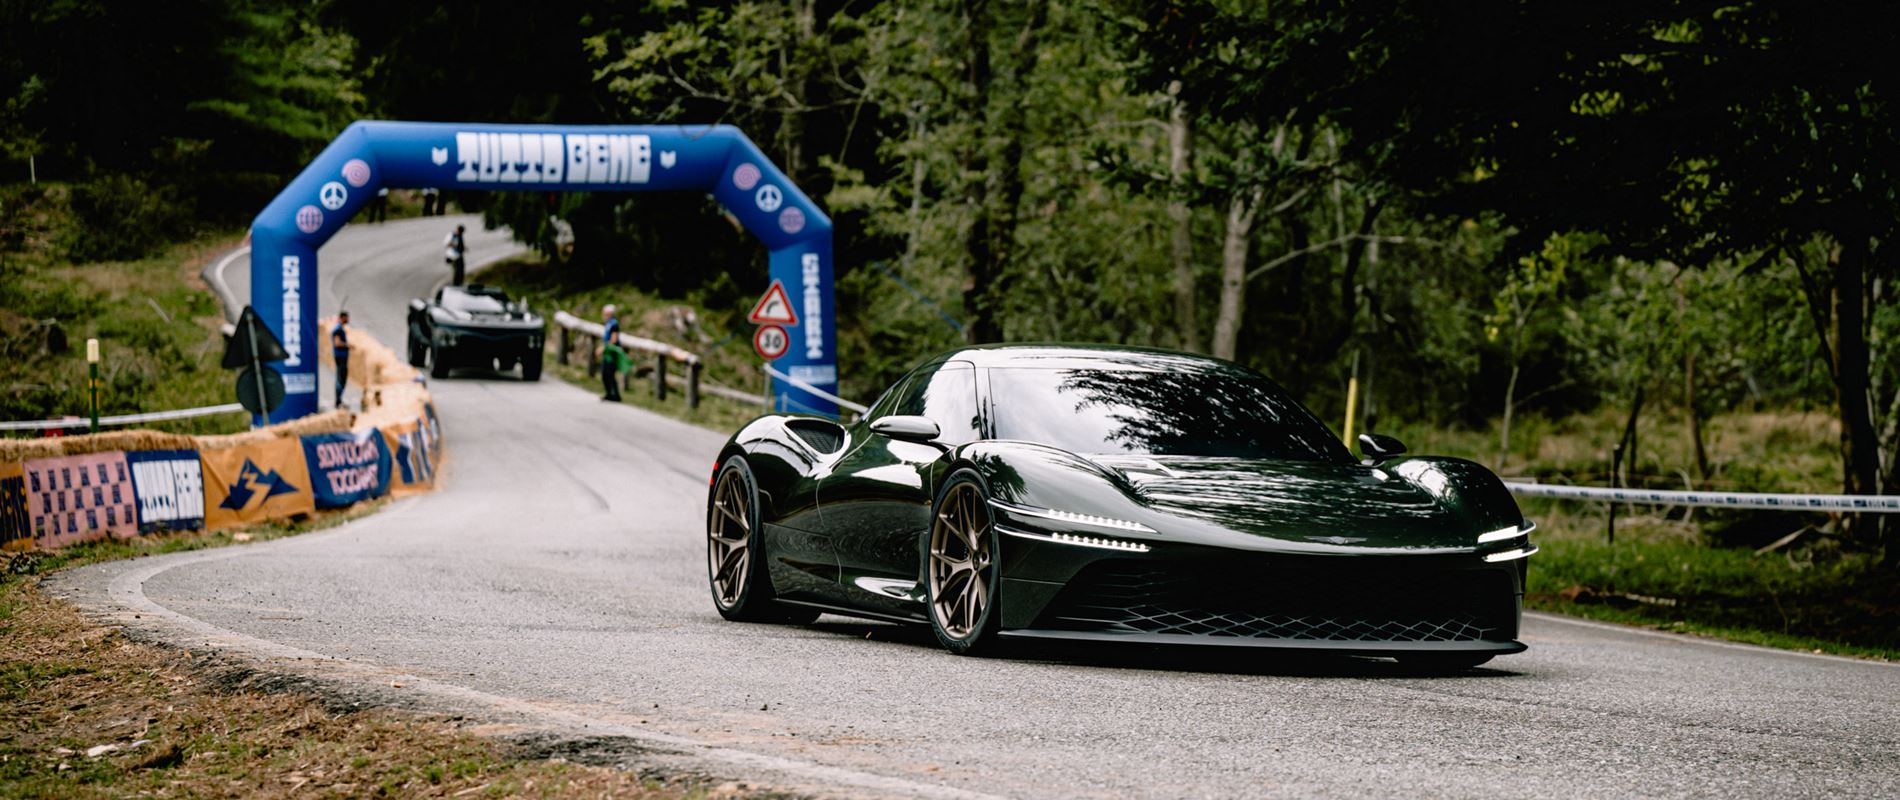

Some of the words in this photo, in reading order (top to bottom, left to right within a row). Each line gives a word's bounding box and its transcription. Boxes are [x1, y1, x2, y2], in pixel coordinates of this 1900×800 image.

[456, 132, 564, 182] TUTTO
[566, 134, 651, 184] BENE
[763, 333, 782, 350] 30
